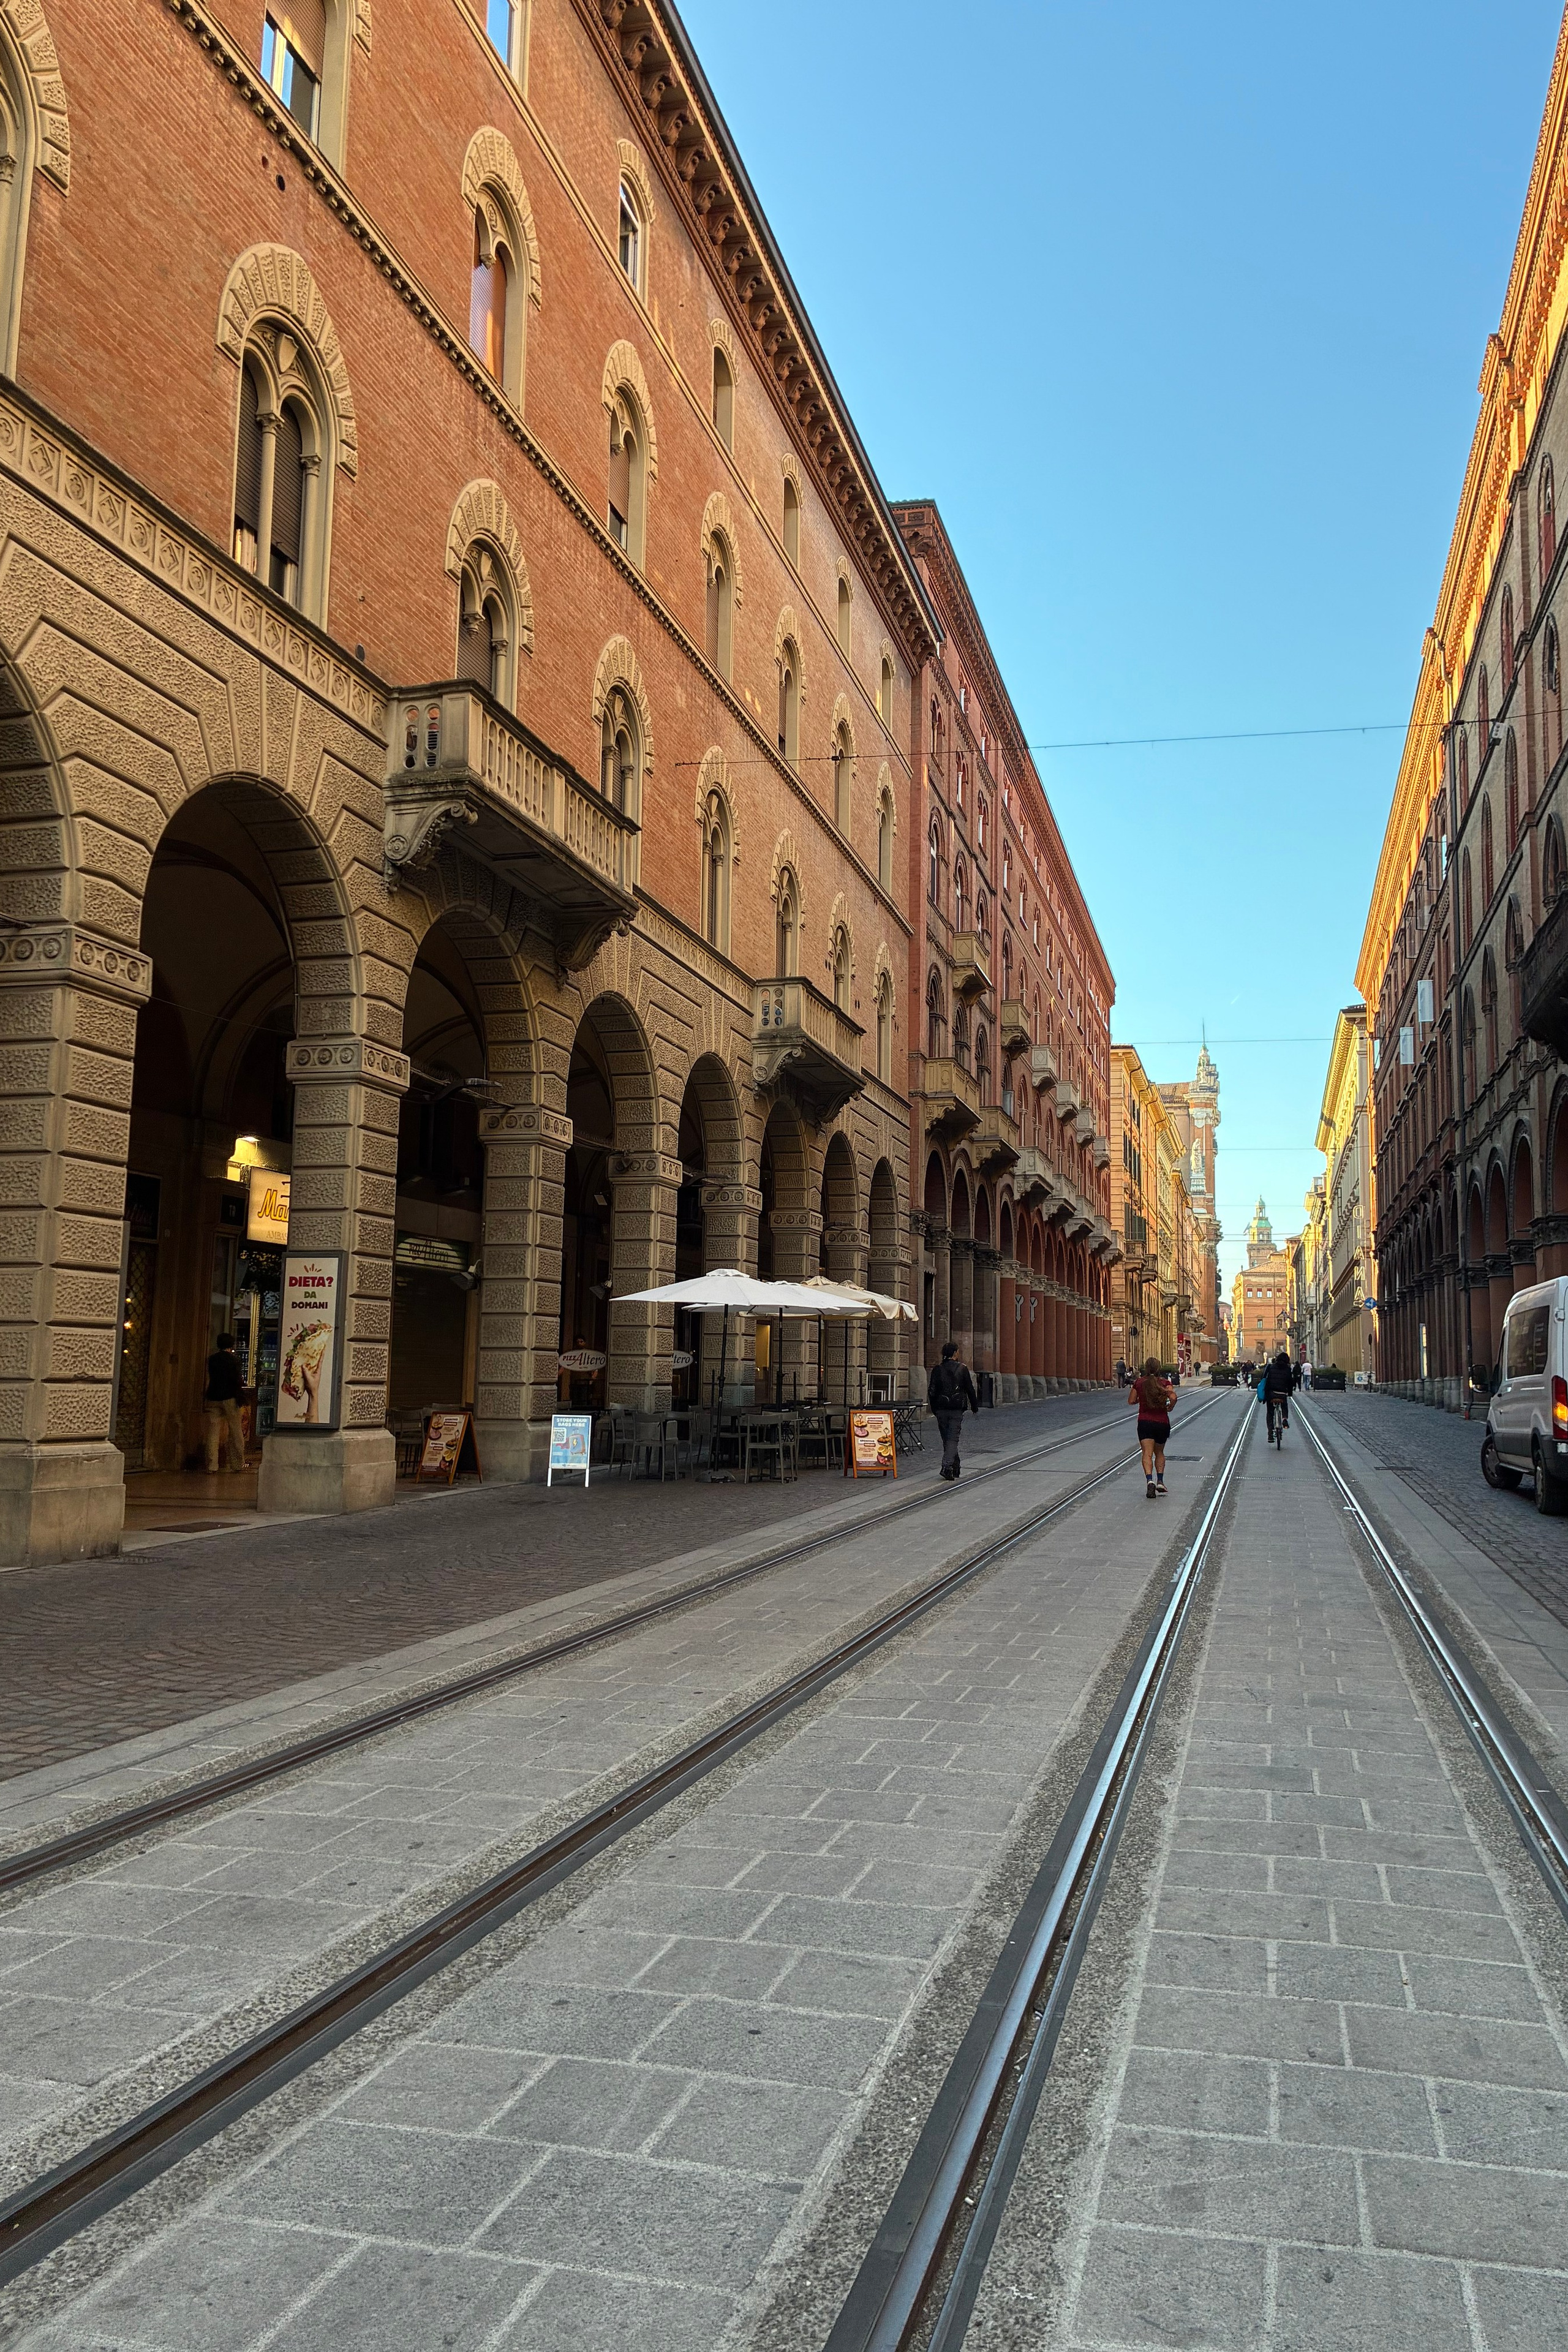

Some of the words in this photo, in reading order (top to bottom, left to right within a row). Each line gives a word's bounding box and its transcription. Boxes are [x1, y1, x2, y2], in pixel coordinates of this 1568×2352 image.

[257, 1188, 290, 1223] Ma
[288, 1276, 334, 1287] DIETA?
[562, 1352, 606, 1366] PIZZAltero
